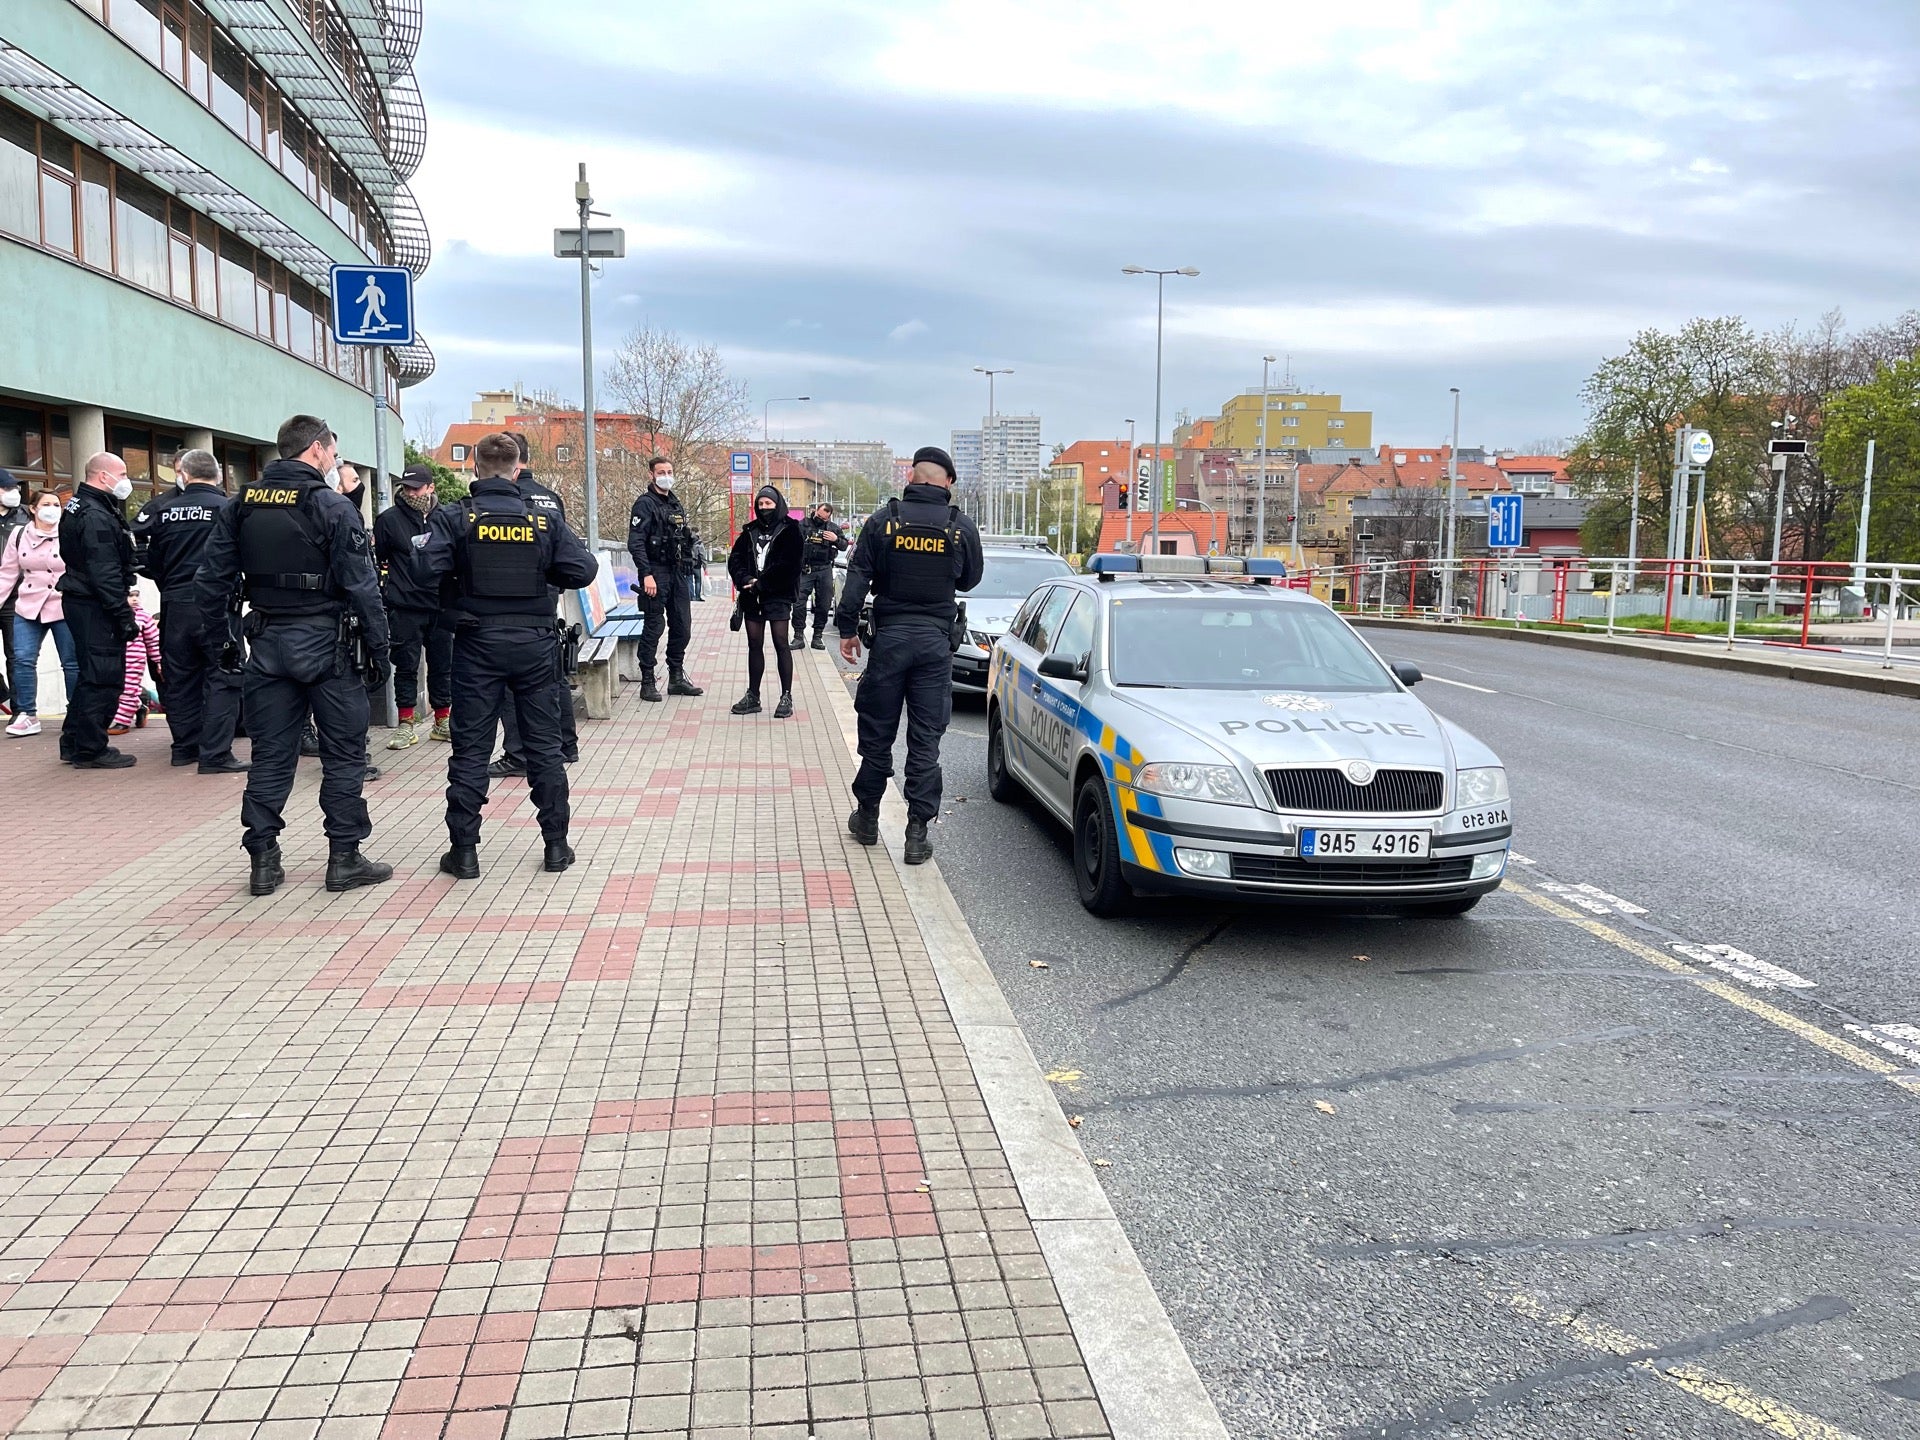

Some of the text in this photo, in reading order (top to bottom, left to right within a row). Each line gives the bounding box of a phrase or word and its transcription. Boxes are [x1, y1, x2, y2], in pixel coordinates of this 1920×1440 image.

[1139, 466, 1149, 501] MND
[244, 488, 298, 504] POLICIE
[161, 510, 213, 523] POLICIE
[478, 525, 534, 541] POLICIE
[895, 535, 945, 552] POLICIE
[1030, 705, 1072, 764] POLICIE
[1219, 718, 1425, 738] POLICIE
[1303, 845, 1313, 853] CZ
[1319, 833, 1420, 854] 9A5 4916
